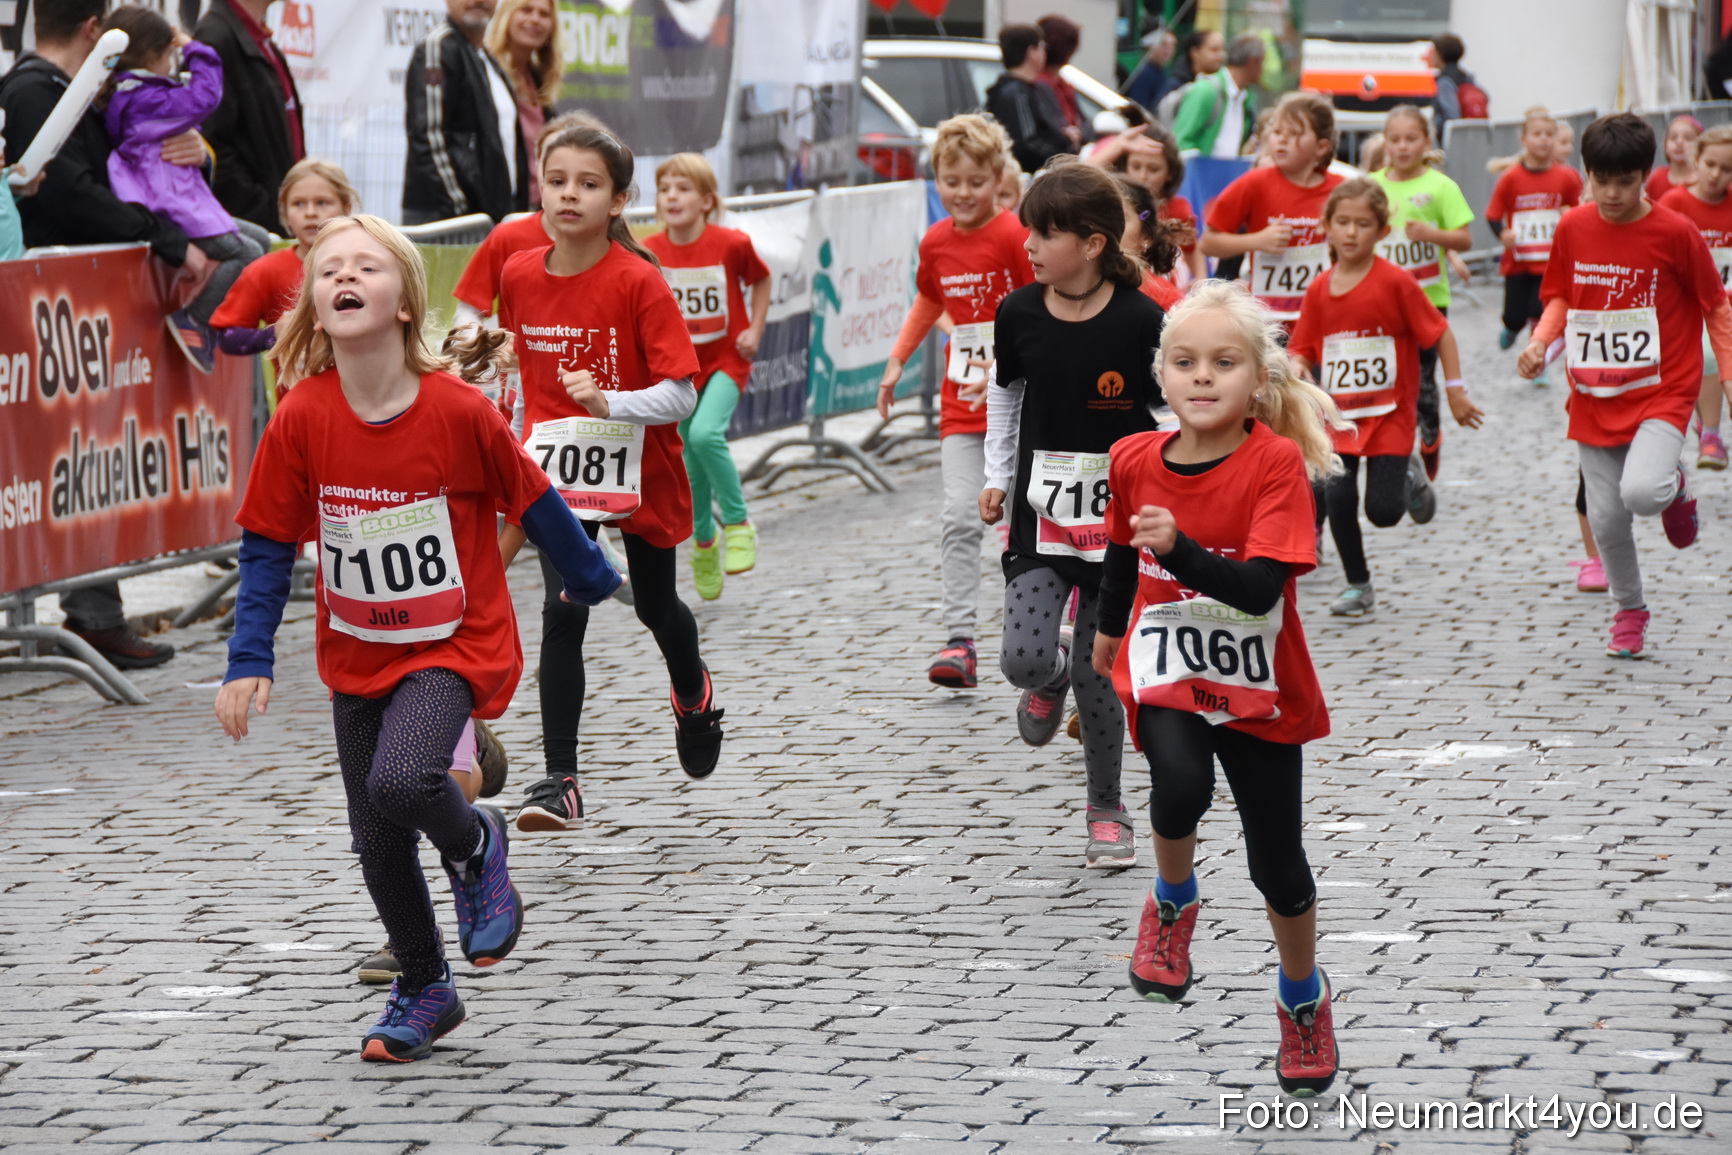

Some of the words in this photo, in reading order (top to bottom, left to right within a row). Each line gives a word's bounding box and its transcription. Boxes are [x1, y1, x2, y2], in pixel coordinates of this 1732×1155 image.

[1574, 261, 1631, 275] Neumarkter
[1574, 274, 1618, 288] Stadtlauf
[521, 324, 583, 337] Neumarkter
[36, 296, 110, 399] 80er
[132, 347, 151, 383] die
[525, 339, 568, 354] Stadtlauf
[1577, 331, 1651, 363] 7152
[1327, 357, 1388, 390] 7253
[577, 421, 634, 437] BOCK
[53, 421, 168, 518] aktuellen
[177, 409, 228, 490] Hits
[535, 444, 627, 486] 7081
[1042, 463, 1075, 472] NeuerMarkt
[565, 496, 607, 508] melie
[360, 504, 437, 535] BOCK
[324, 535, 446, 595] 7108
[450, 576, 457, 586] K
[369, 608, 410, 626] Jule
[1141, 626, 1270, 682] 7060
